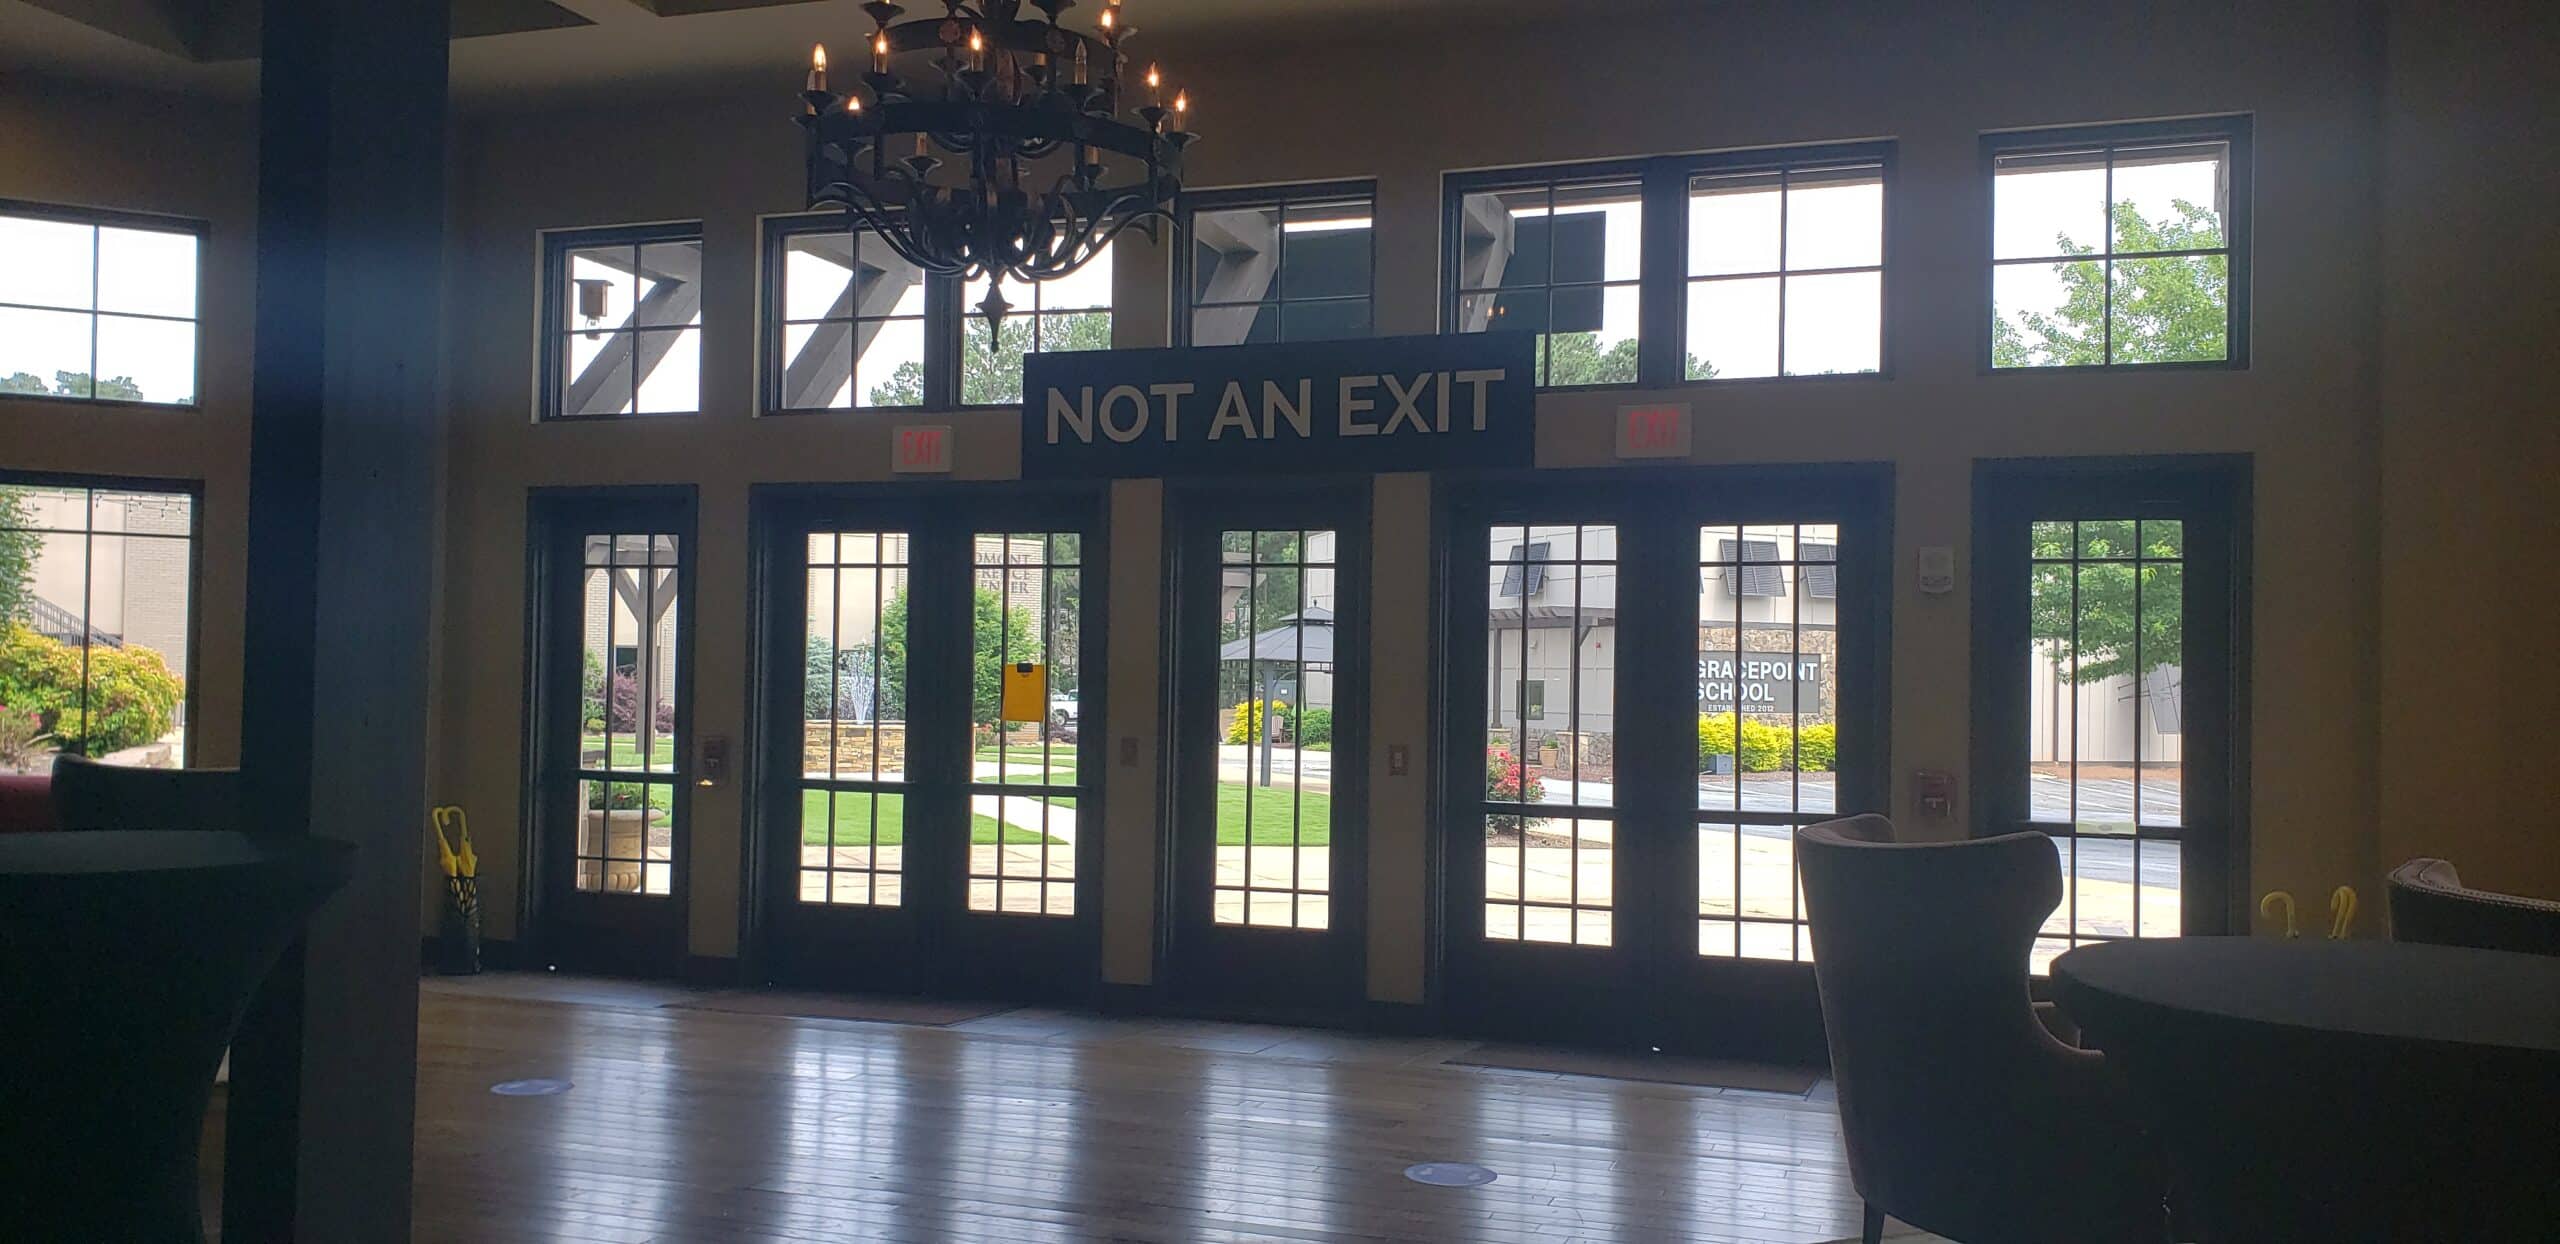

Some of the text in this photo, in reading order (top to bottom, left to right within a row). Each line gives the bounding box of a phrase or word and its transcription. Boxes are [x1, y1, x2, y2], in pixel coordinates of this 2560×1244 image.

[1046, 368, 1506, 444] NOT AN EXIT
[902, 431, 944, 465] EXIT
[1627, 409, 1680, 449] EXIT
